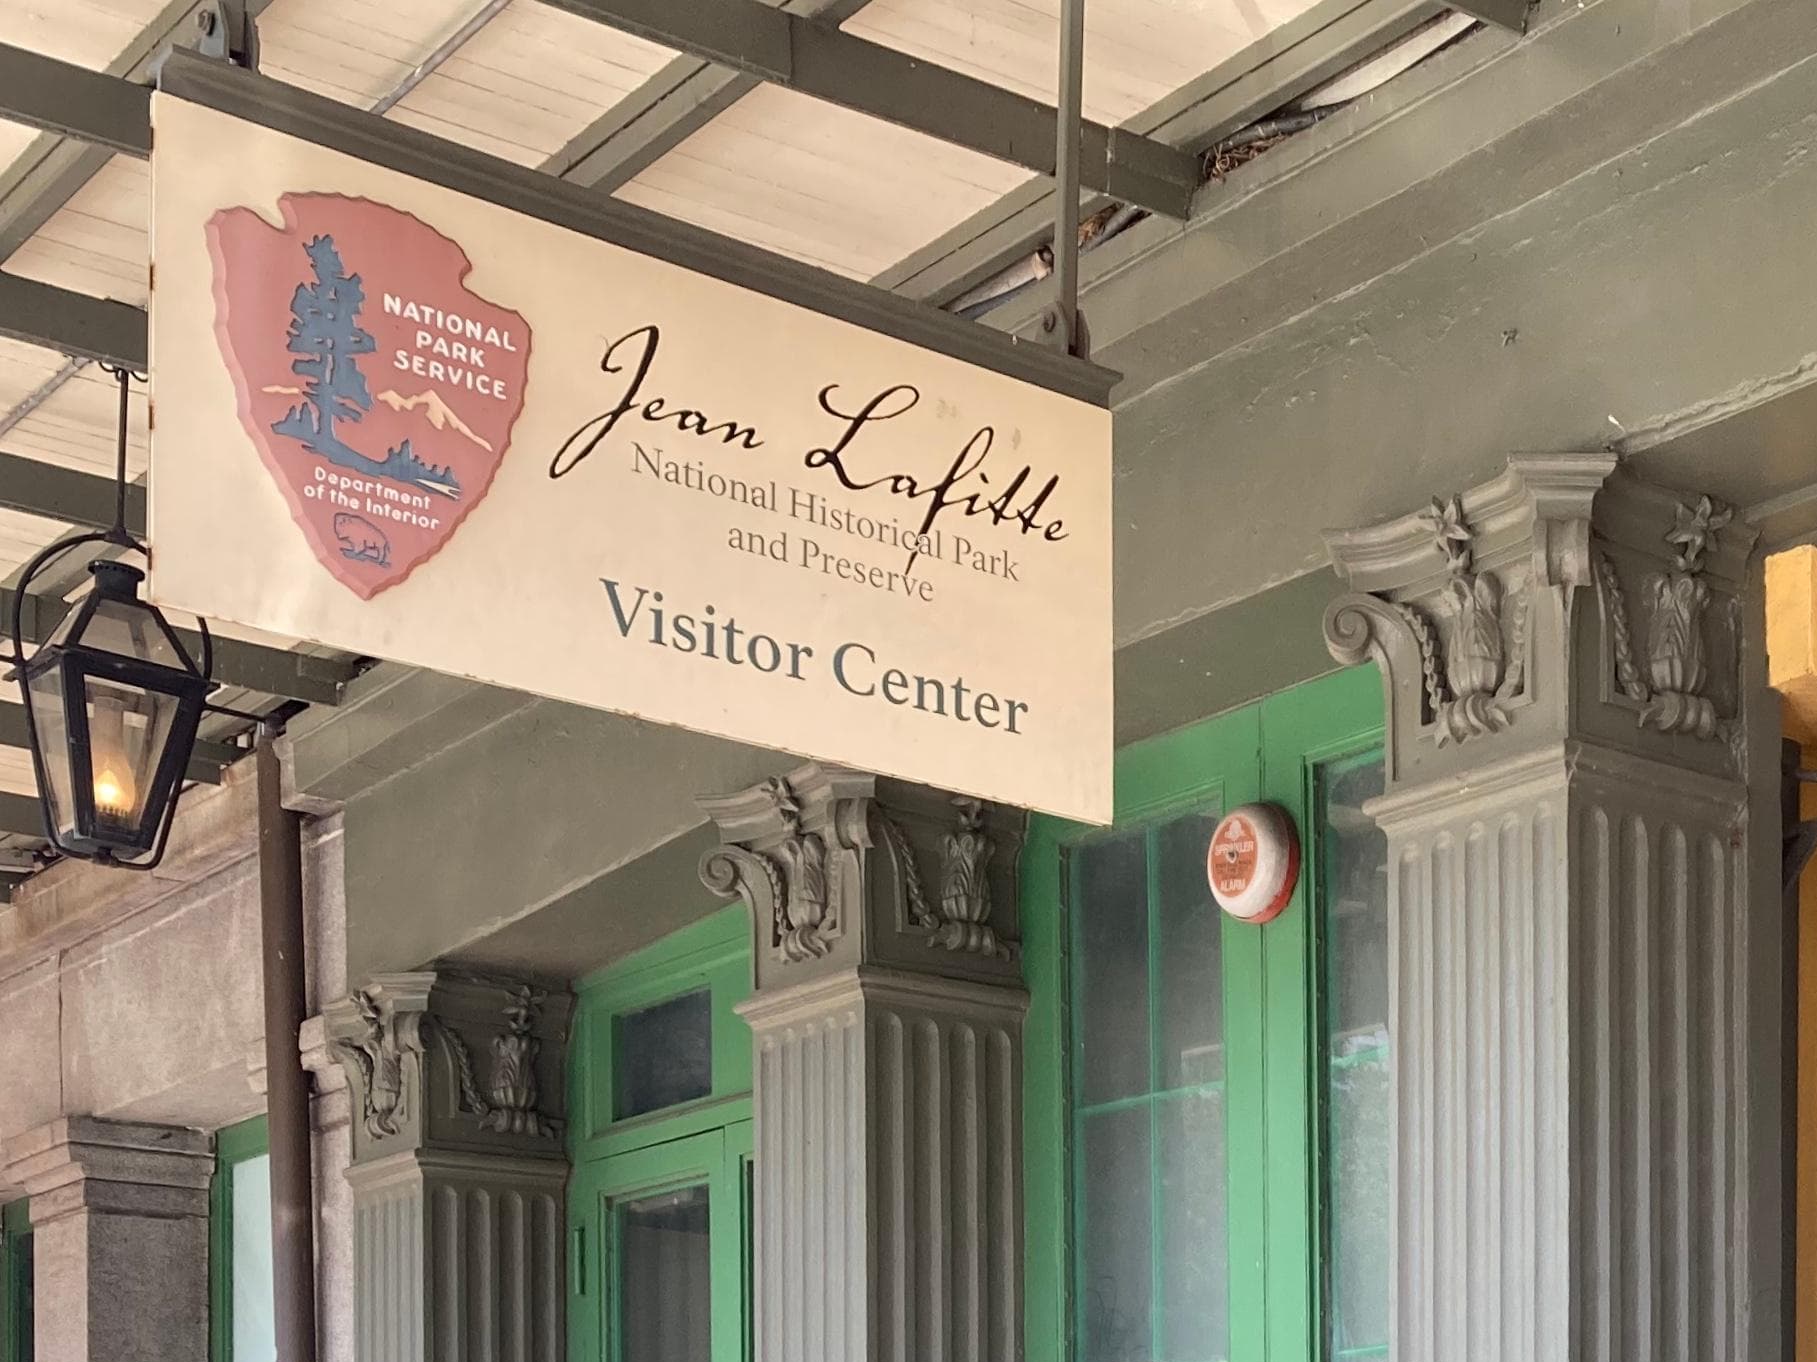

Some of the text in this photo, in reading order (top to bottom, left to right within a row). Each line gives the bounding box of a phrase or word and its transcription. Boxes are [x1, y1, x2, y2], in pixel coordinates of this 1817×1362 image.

[383, 292, 517, 351] NATIONAL
[416, 329, 486, 368] PARK
[393, 350, 507, 400] SERVICE
[549, 325, 1070, 577] Jean Lafitte
[304, 483, 440, 530] of the Interior
[314, 466, 432, 510] Department
[631, 442, 1020, 583] National Historical Park
[727, 524, 935, 603] and Preserve
[599, 577, 1030, 736] Visitor Center
[1220, 879, 1246, 891] ALARM
